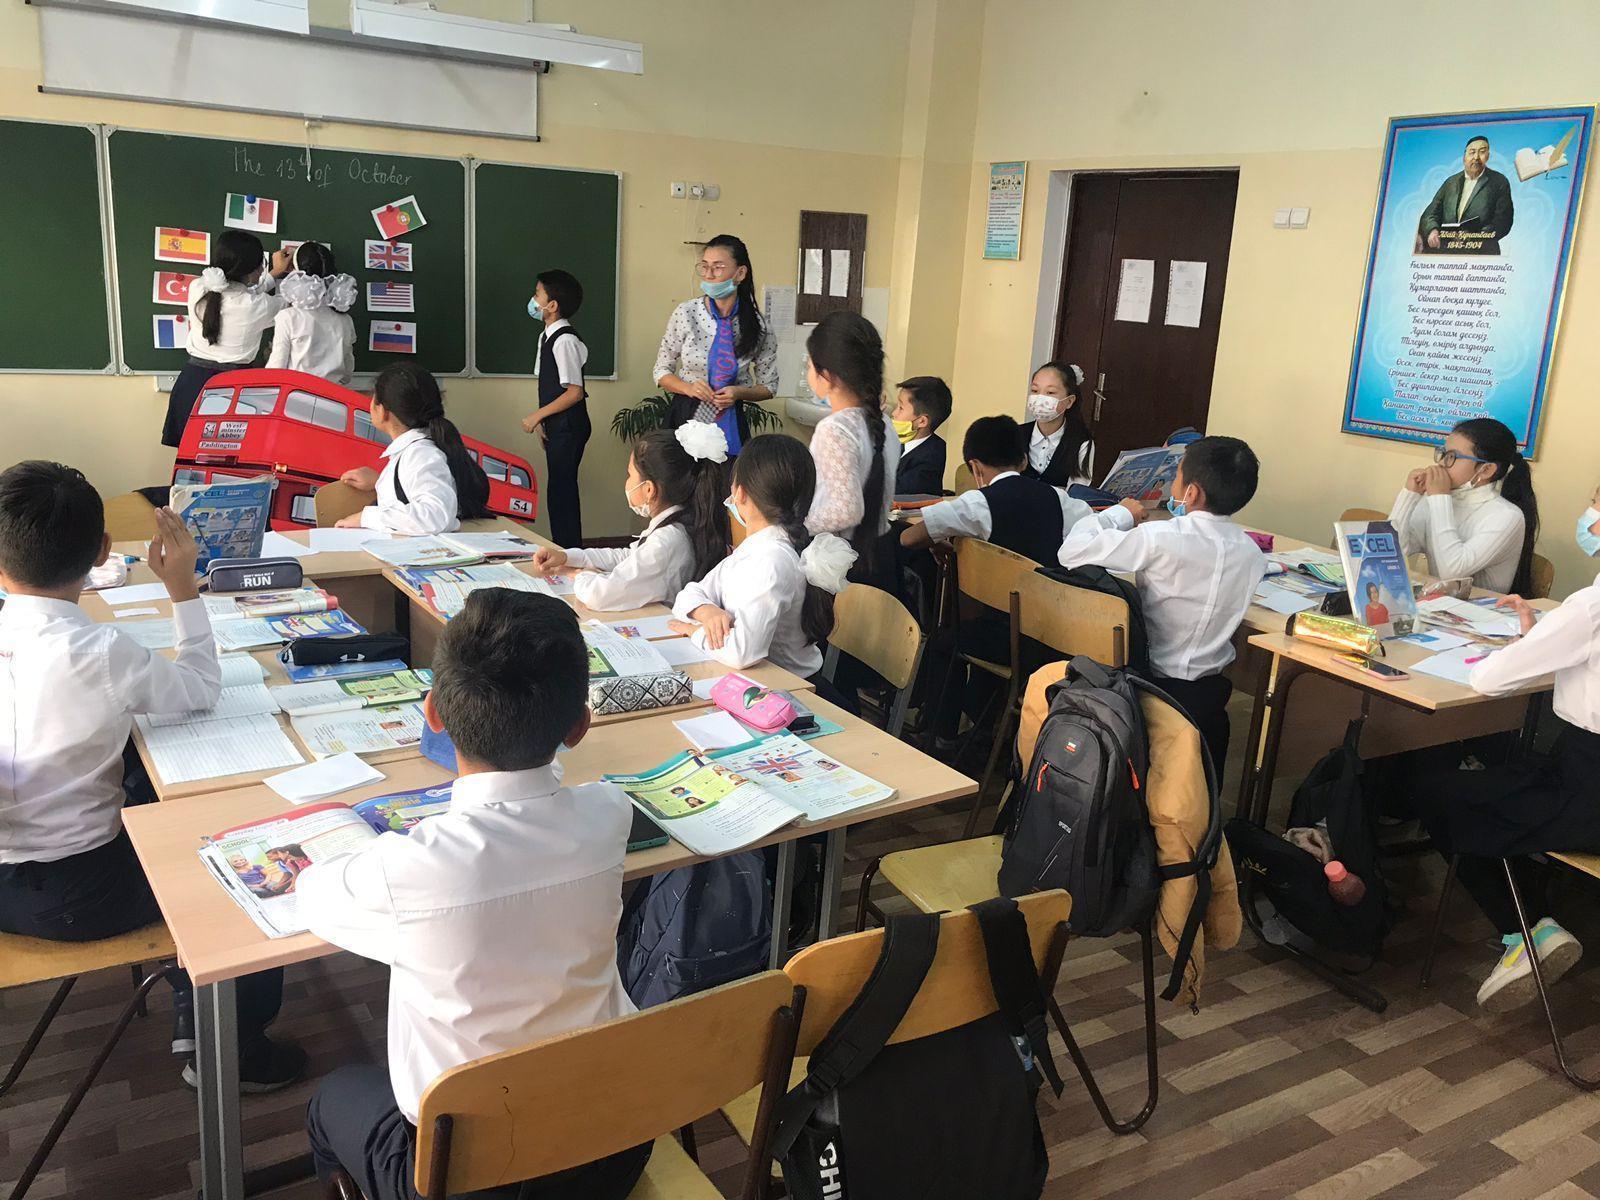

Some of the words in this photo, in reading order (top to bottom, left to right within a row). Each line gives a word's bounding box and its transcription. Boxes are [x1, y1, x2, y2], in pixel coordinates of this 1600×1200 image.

[234, 146, 265, 176] The
[315, 164, 334, 188] of
[350, 158, 412, 186] October
[1447, 241, 1483, 249] 1845-1904
[1437, 262, 1467, 270] таппай
[1412, 272, 1432, 281] Орын
[1434, 273, 1464, 281] таппай
[1408, 304, 1420, 312] Бес
[1412, 316, 1424, 324] Бес
[513, 500, 528, 512] 54
[1347, 537, 1395, 554] EXCEL
[243, 576, 272, 588] RUN
[818, 1141, 842, 1200] CH
